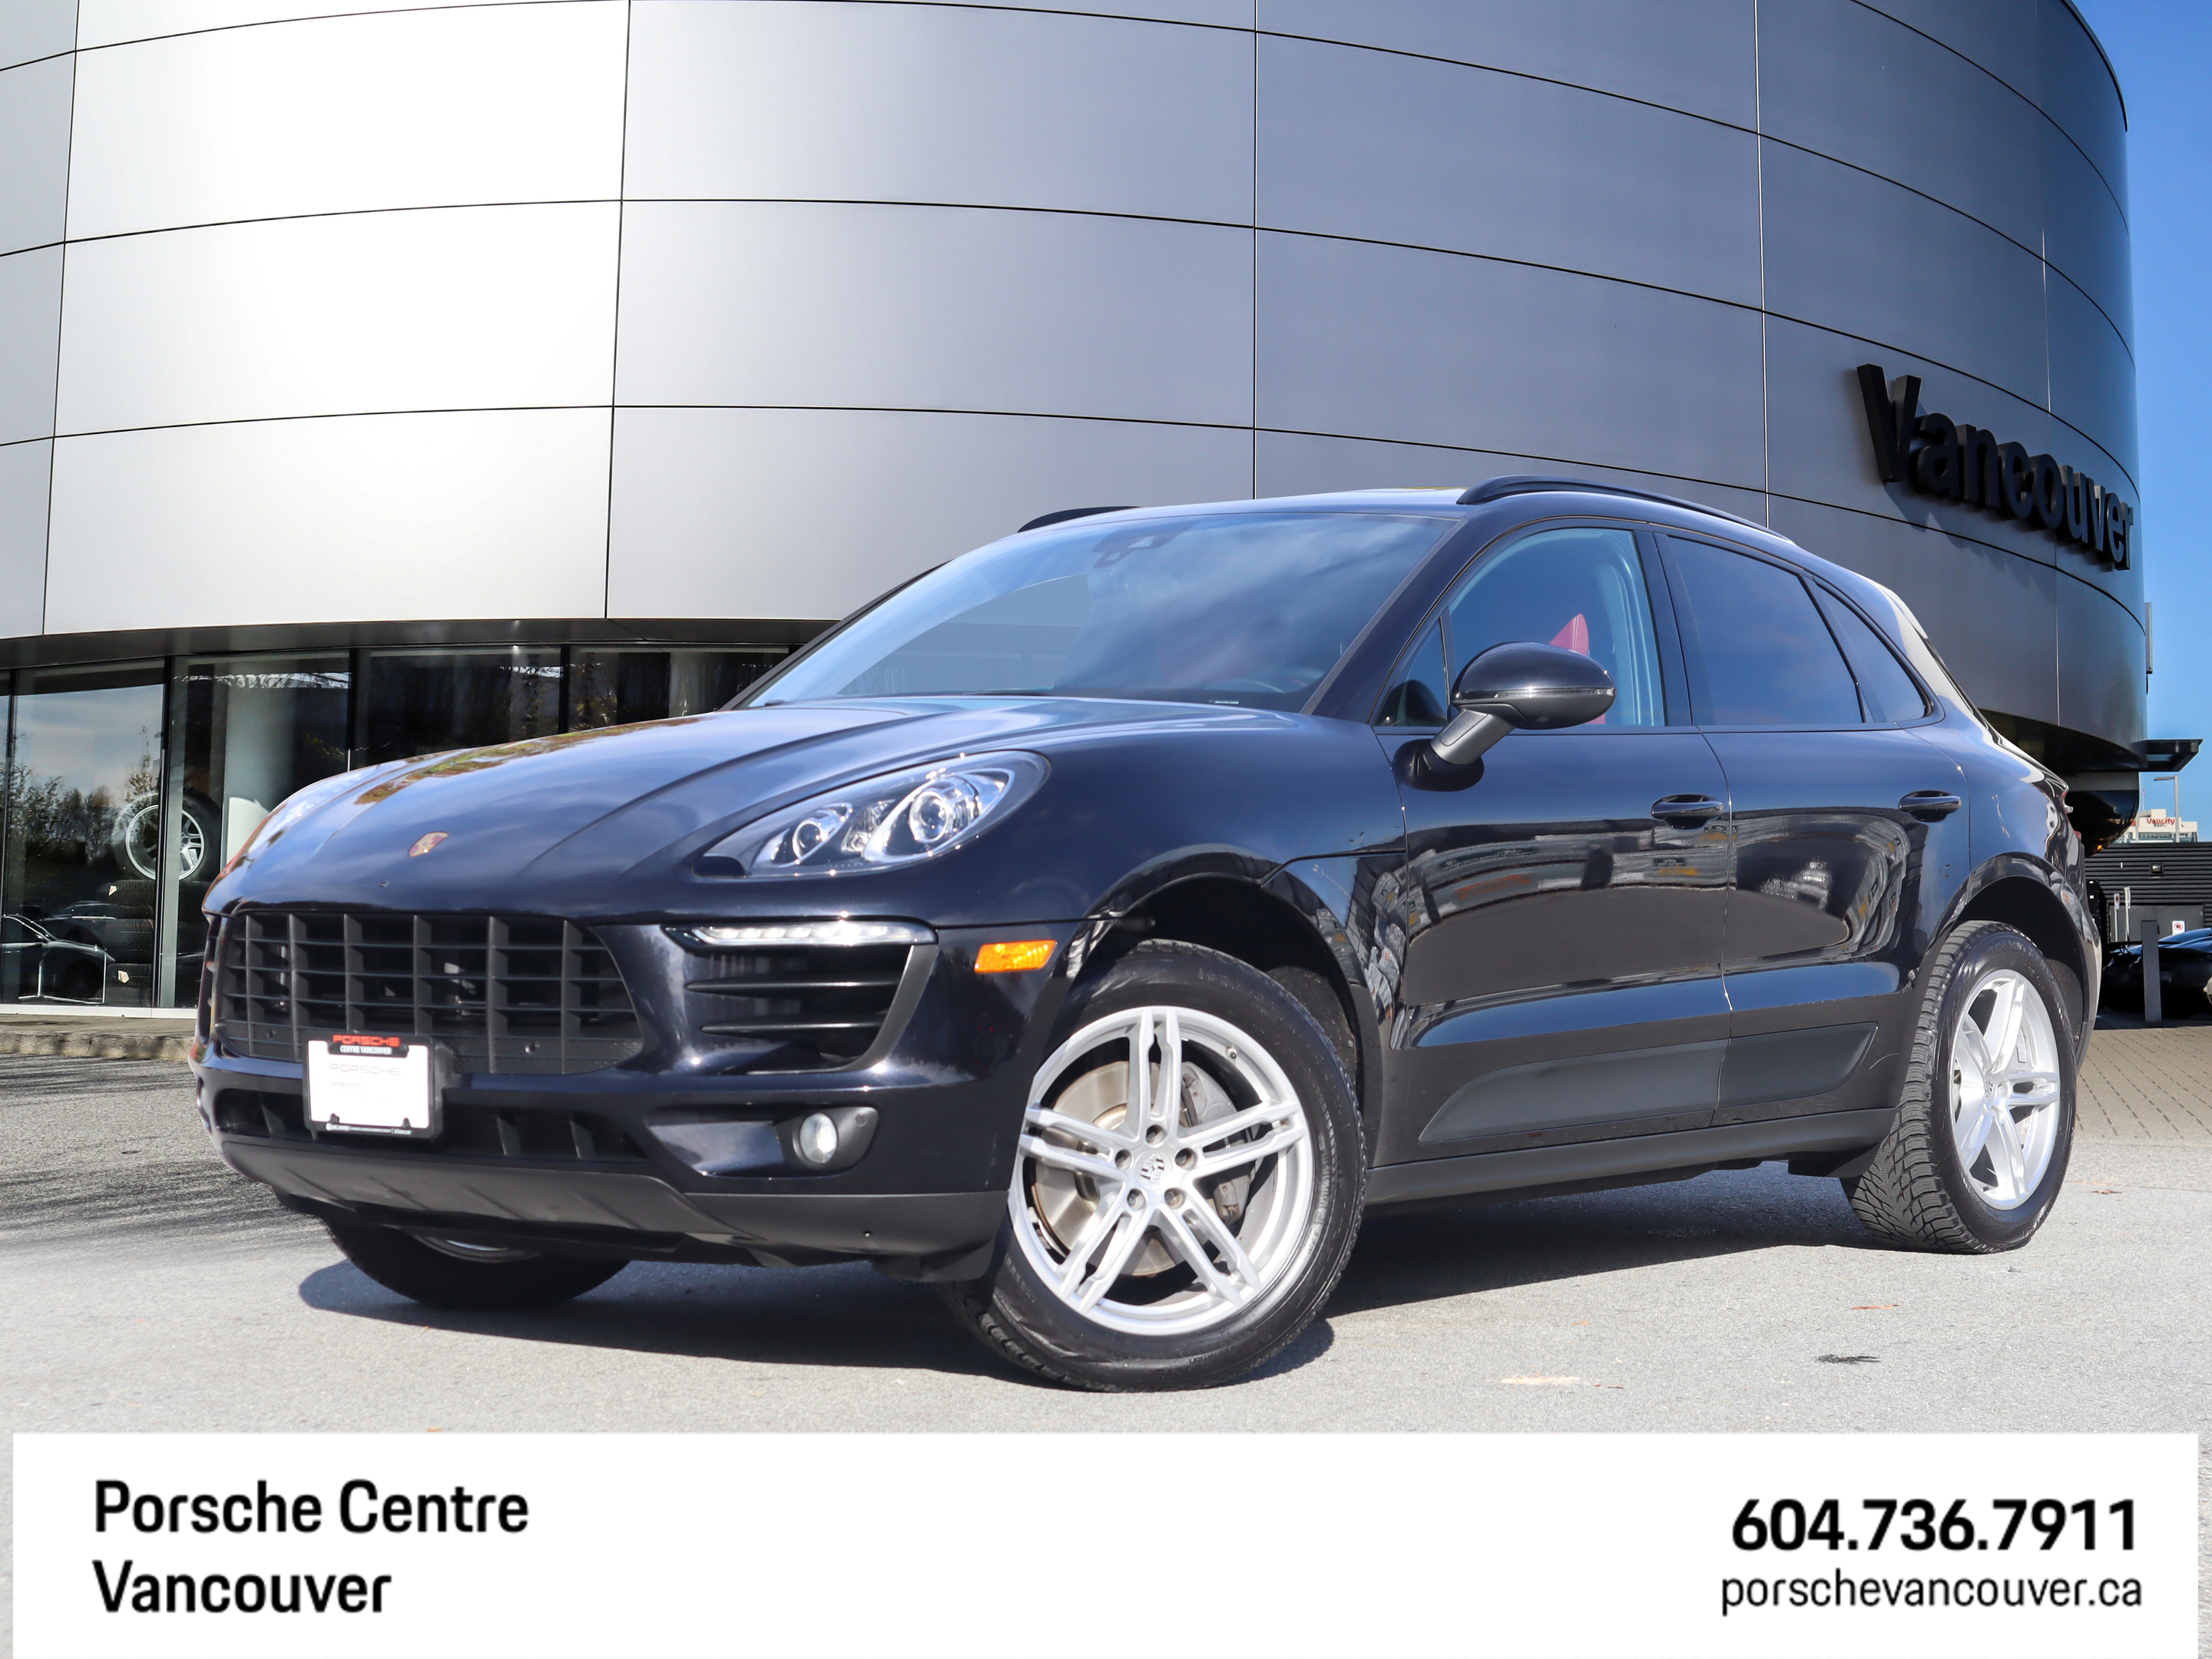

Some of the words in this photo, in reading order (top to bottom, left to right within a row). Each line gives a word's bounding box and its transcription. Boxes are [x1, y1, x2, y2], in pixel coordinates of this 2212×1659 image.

[1856, 363, 2134, 571] Vancouver
[333, 1035, 400, 1047] PORSCHE
[340, 1045, 360, 1054] CENTRE
[360, 1046, 392, 1055] VANCOUVER
[329, 1064, 401, 1076] PORSCHE
